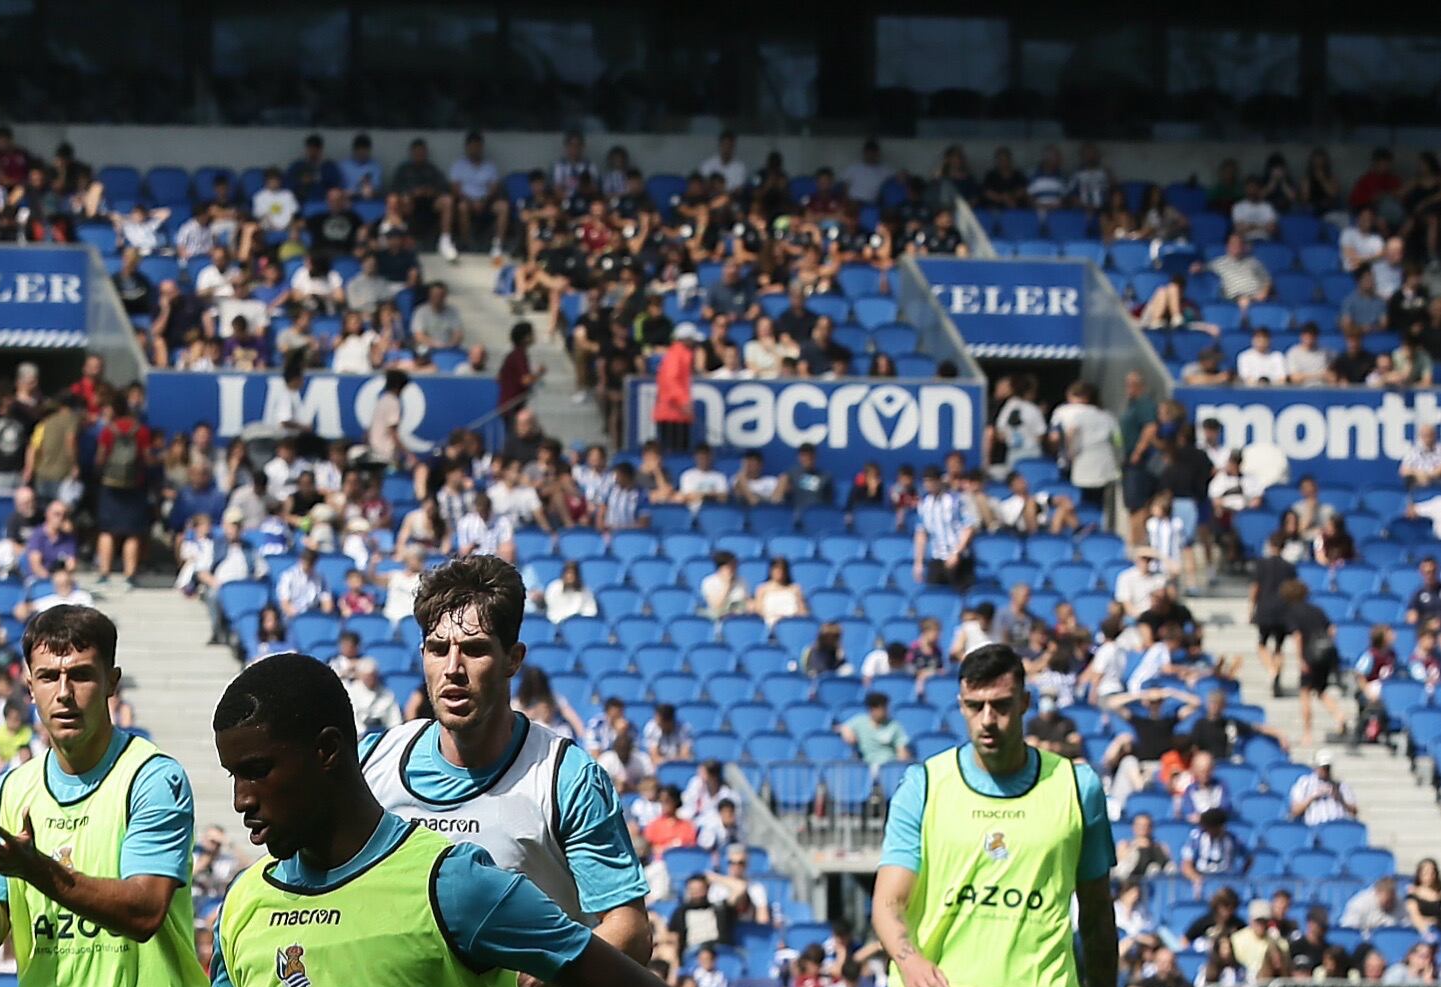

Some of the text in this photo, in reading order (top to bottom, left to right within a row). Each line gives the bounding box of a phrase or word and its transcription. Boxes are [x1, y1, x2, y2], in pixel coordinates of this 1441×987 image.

[930, 284, 1079, 316] ELER
[971, 809, 1026, 820] macron
[269, 908, 341, 927] macron
